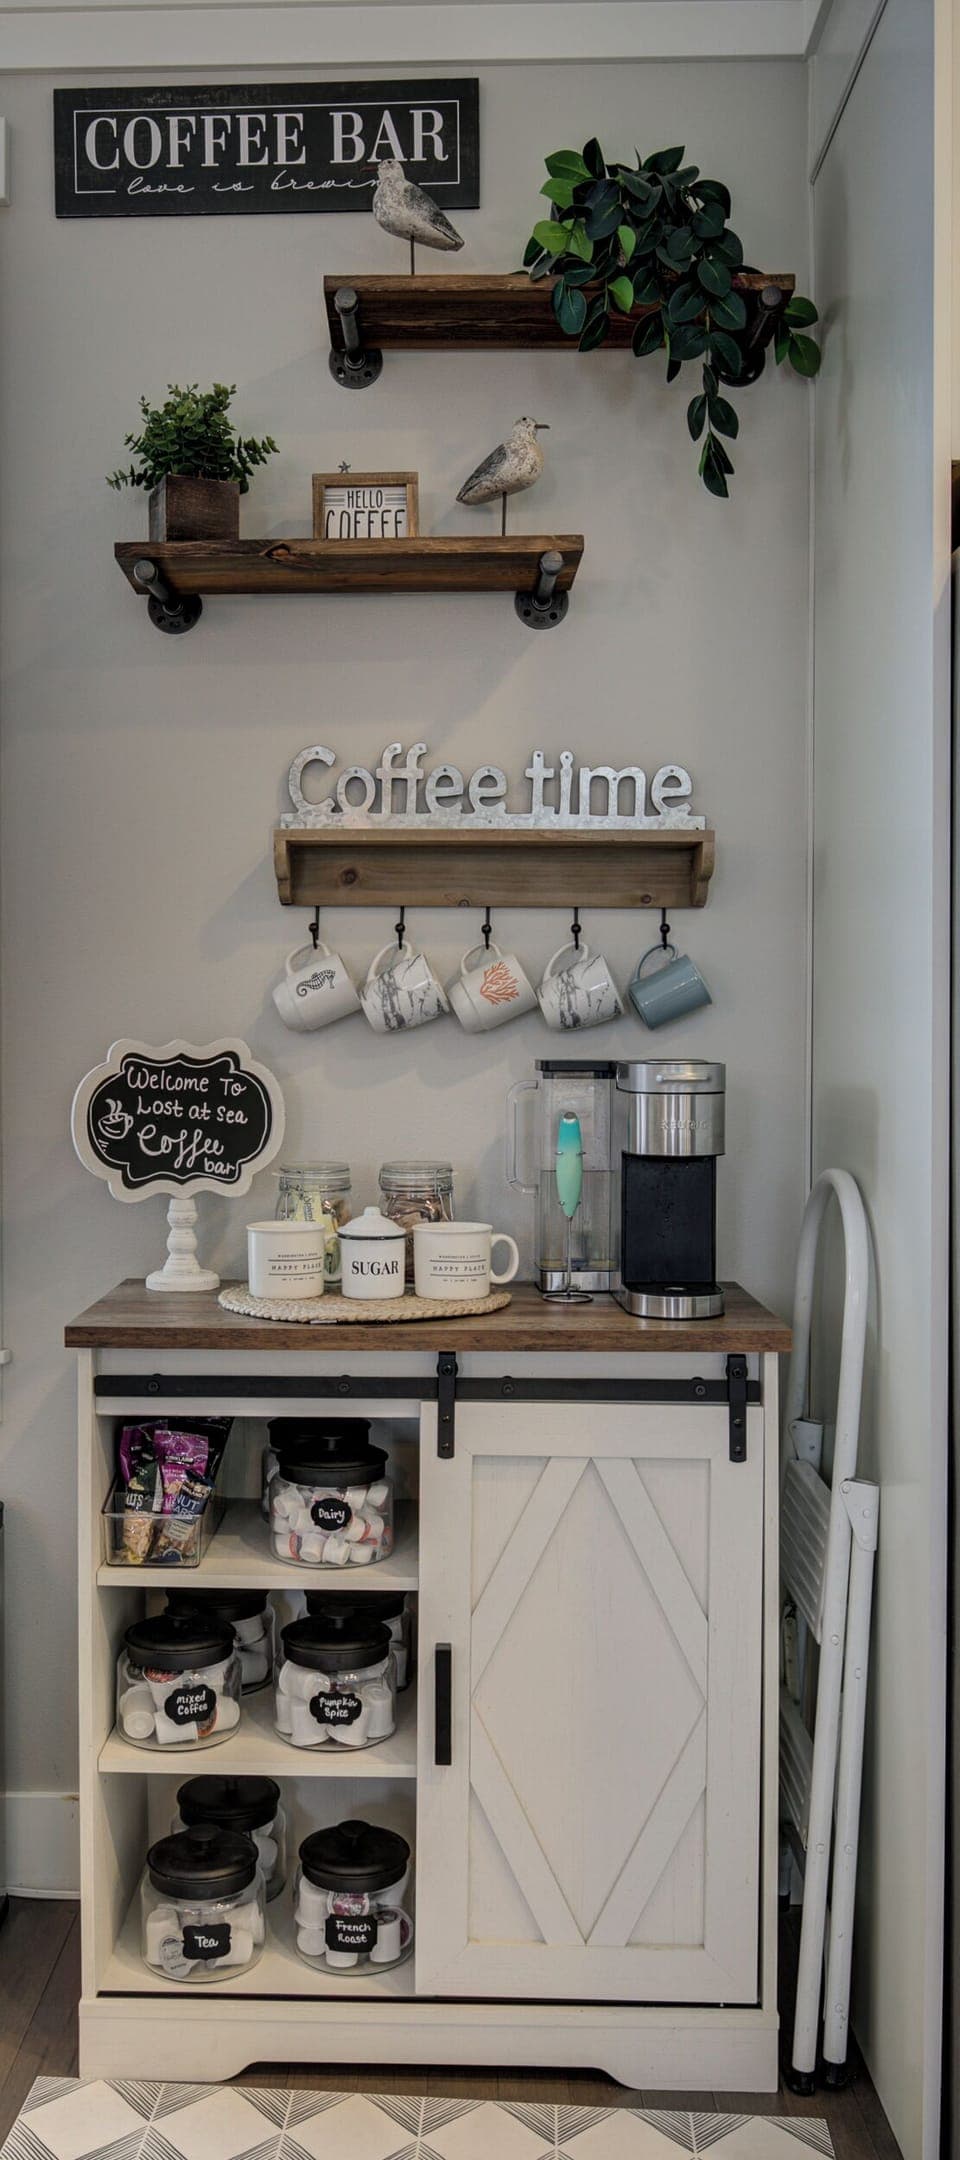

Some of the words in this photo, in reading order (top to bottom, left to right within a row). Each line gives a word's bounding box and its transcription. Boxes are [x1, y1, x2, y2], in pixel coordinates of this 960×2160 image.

[84, 112, 307, 170] COFFEE
[328, 109, 449, 164] BAR
[127, 175, 194, 196] love
[211, 180, 254, 192] is
[347, 490, 383, 509] HELLO
[288, 742, 508, 816] Coffee
[525, 750, 693, 816] time
[127, 1065, 209, 1092] Welcome
[219, 1077, 247, 1096] To
[137, 1096, 184, 1117] Lost
[188, 1102, 212, 1120] at
[137, 1124, 225, 1169] Coffee
[203, 1157, 236, 1175] bar
[351, 1260, 399, 1276] SUGAR
[318, 1508, 345, 1524] Dairy
[177, 1703, 208, 1716] Coffee
[325, 1707, 349, 1720] Spice
[335, 1920, 371, 1932] French
[194, 1935, 219, 1949] Tea
[338, 1933, 368, 1943] Roast
